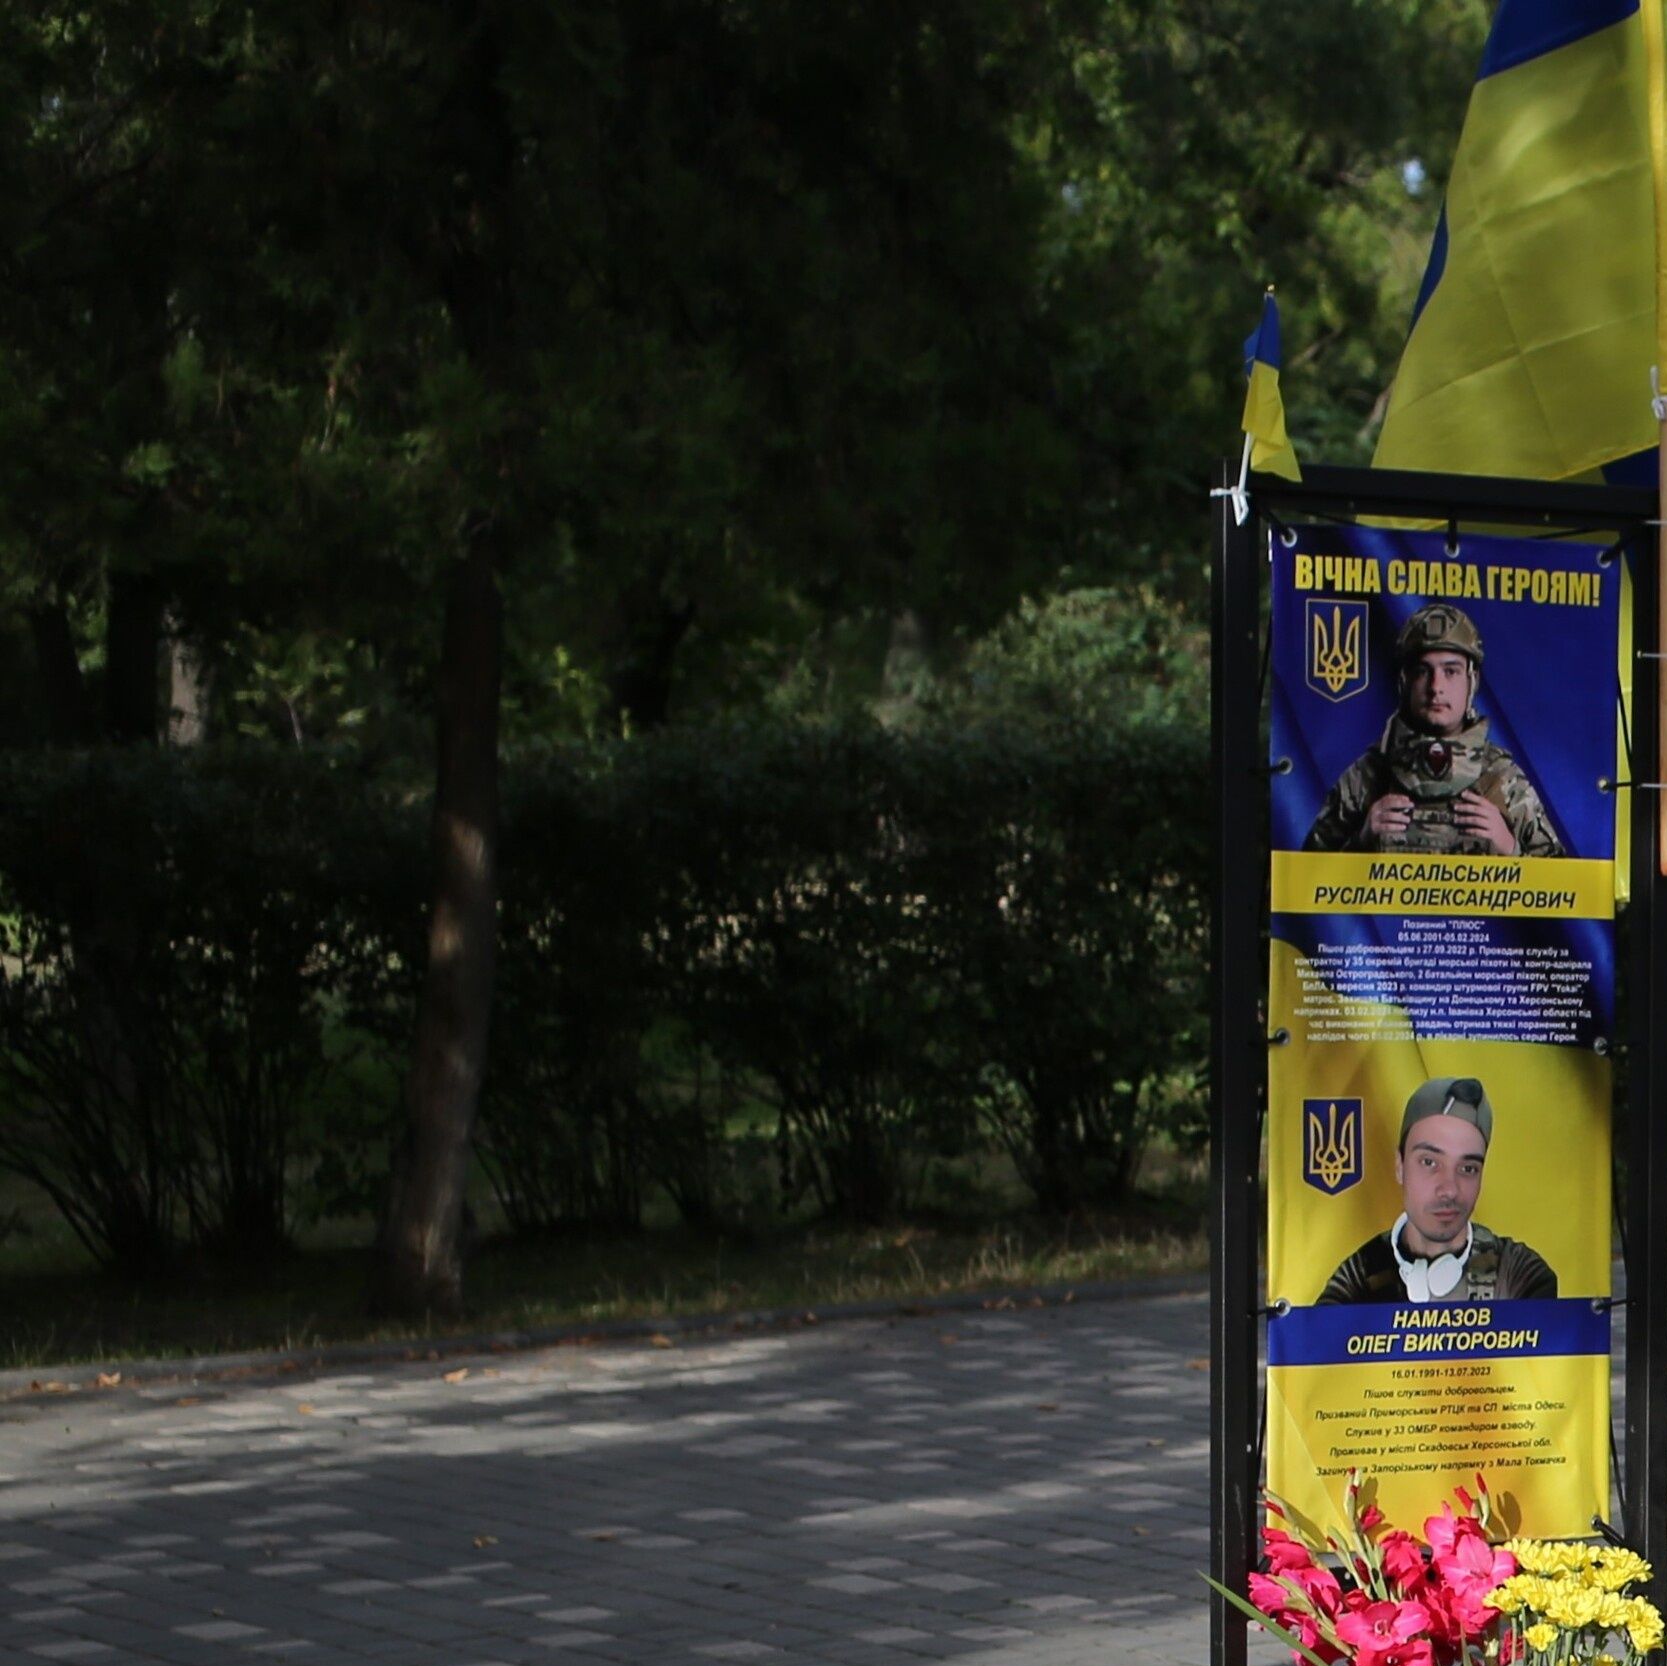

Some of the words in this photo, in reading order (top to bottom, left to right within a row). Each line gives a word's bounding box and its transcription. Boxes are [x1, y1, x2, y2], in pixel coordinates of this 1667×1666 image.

[1294, 554, 1381, 594] ВІЧНА
[1388, 560, 1482, 599] СЛАВА
[1486, 566, 1601, 606] ГЕРОЯМ!
[1368, 861, 1522, 884] МАСАЛЬСЬКИЙ
[1314, 885, 1395, 906] РУСЛАН
[1400, 887, 1576, 911] ОЛЕКСАНДРОВИЧ
[1393, 1308, 1491, 1329] НАМАЗОВ
[1346, 1333, 1400, 1355] ОЛЕГ
[1404, 1329, 1539, 1353] ВИКТОРОВИЧ
[1392, 1366, 1491, 1378] 16.01.1991-13.07.2023
[1364, 1389, 1394, 1399] Пішов
[1396, 1388, 1442, 1400] служити
[1444, 1386, 1516, 1396] добровольцем.
[1315, 1410, 1367, 1422] Призваний
[1369, 1407, 1438, 1418] Приморським
[1440, 1404, 1466, 1415] РТЦК
[1483, 1403, 1498, 1412] СП
[1502, 1402, 1532, 1411] міста
[1534, 1401, 1567, 1410] Одеси.
[1345, 1427, 1382, 1440] Служив
[1407, 1424, 1438, 1434] ОМБР
[1439, 1422, 1498, 1433] командиром
[1330, 1446, 1377, 1458] Проживав
[1380, 1448, 1386, 1456] у
[1418, 1442, 1468, 1452] Скадовськ
[1471, 1439, 1532, 1451] Херсонської
[1534, 1438, 1552, 1448] обл.
[1370, 1463, 1438, 1474] Запорізькому
[1440, 1460, 1486, 1470] напрямку
[1496, 1458, 1522, 1466] Мала
[1525, 1456, 1566, 1466] Токмачка
